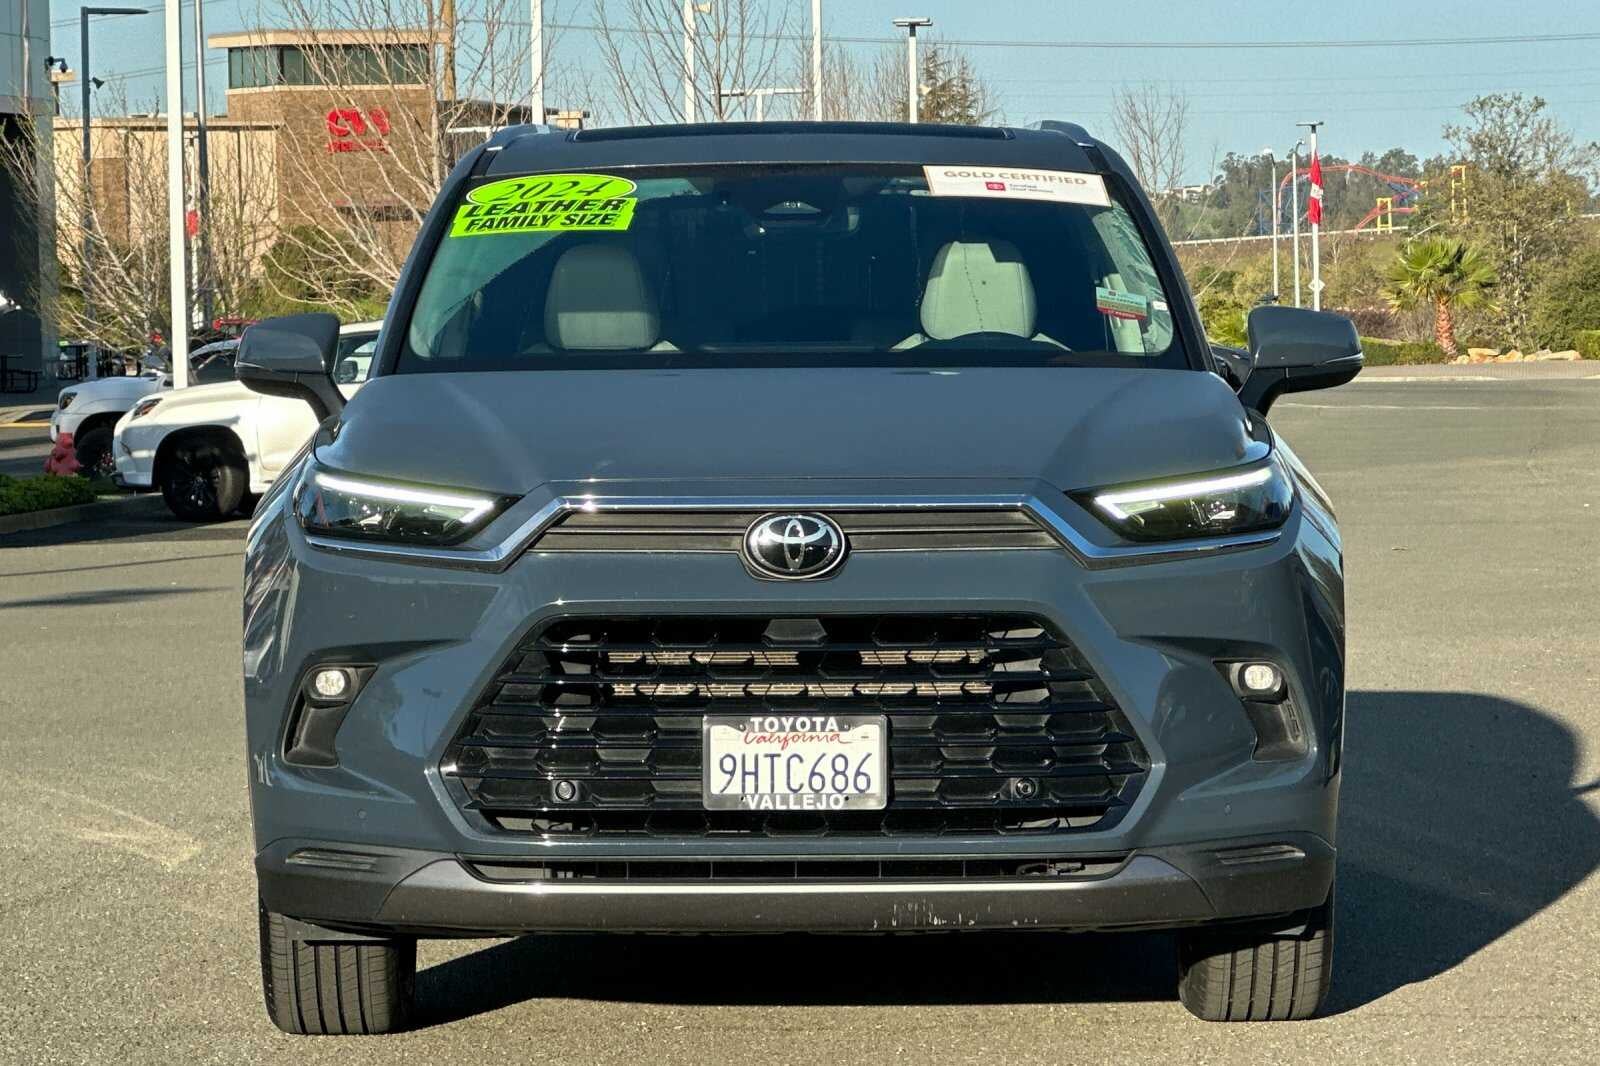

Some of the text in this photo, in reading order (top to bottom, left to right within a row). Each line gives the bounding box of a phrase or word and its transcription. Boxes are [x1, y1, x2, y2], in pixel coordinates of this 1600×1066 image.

[943, 170, 995, 179] GOLD
[998, 171, 1087, 186] CERTIFIED
[488, 179, 614, 202] 2024
[464, 200, 626, 218] LEATHER
[464, 213, 617, 232] FAMILY SIZE
[750, 716, 839, 732] TOYOTA
[744, 731, 852, 750] California
[719, 753, 873, 794] 9HTC686
[746, 794, 844, 810] VALLEJO
